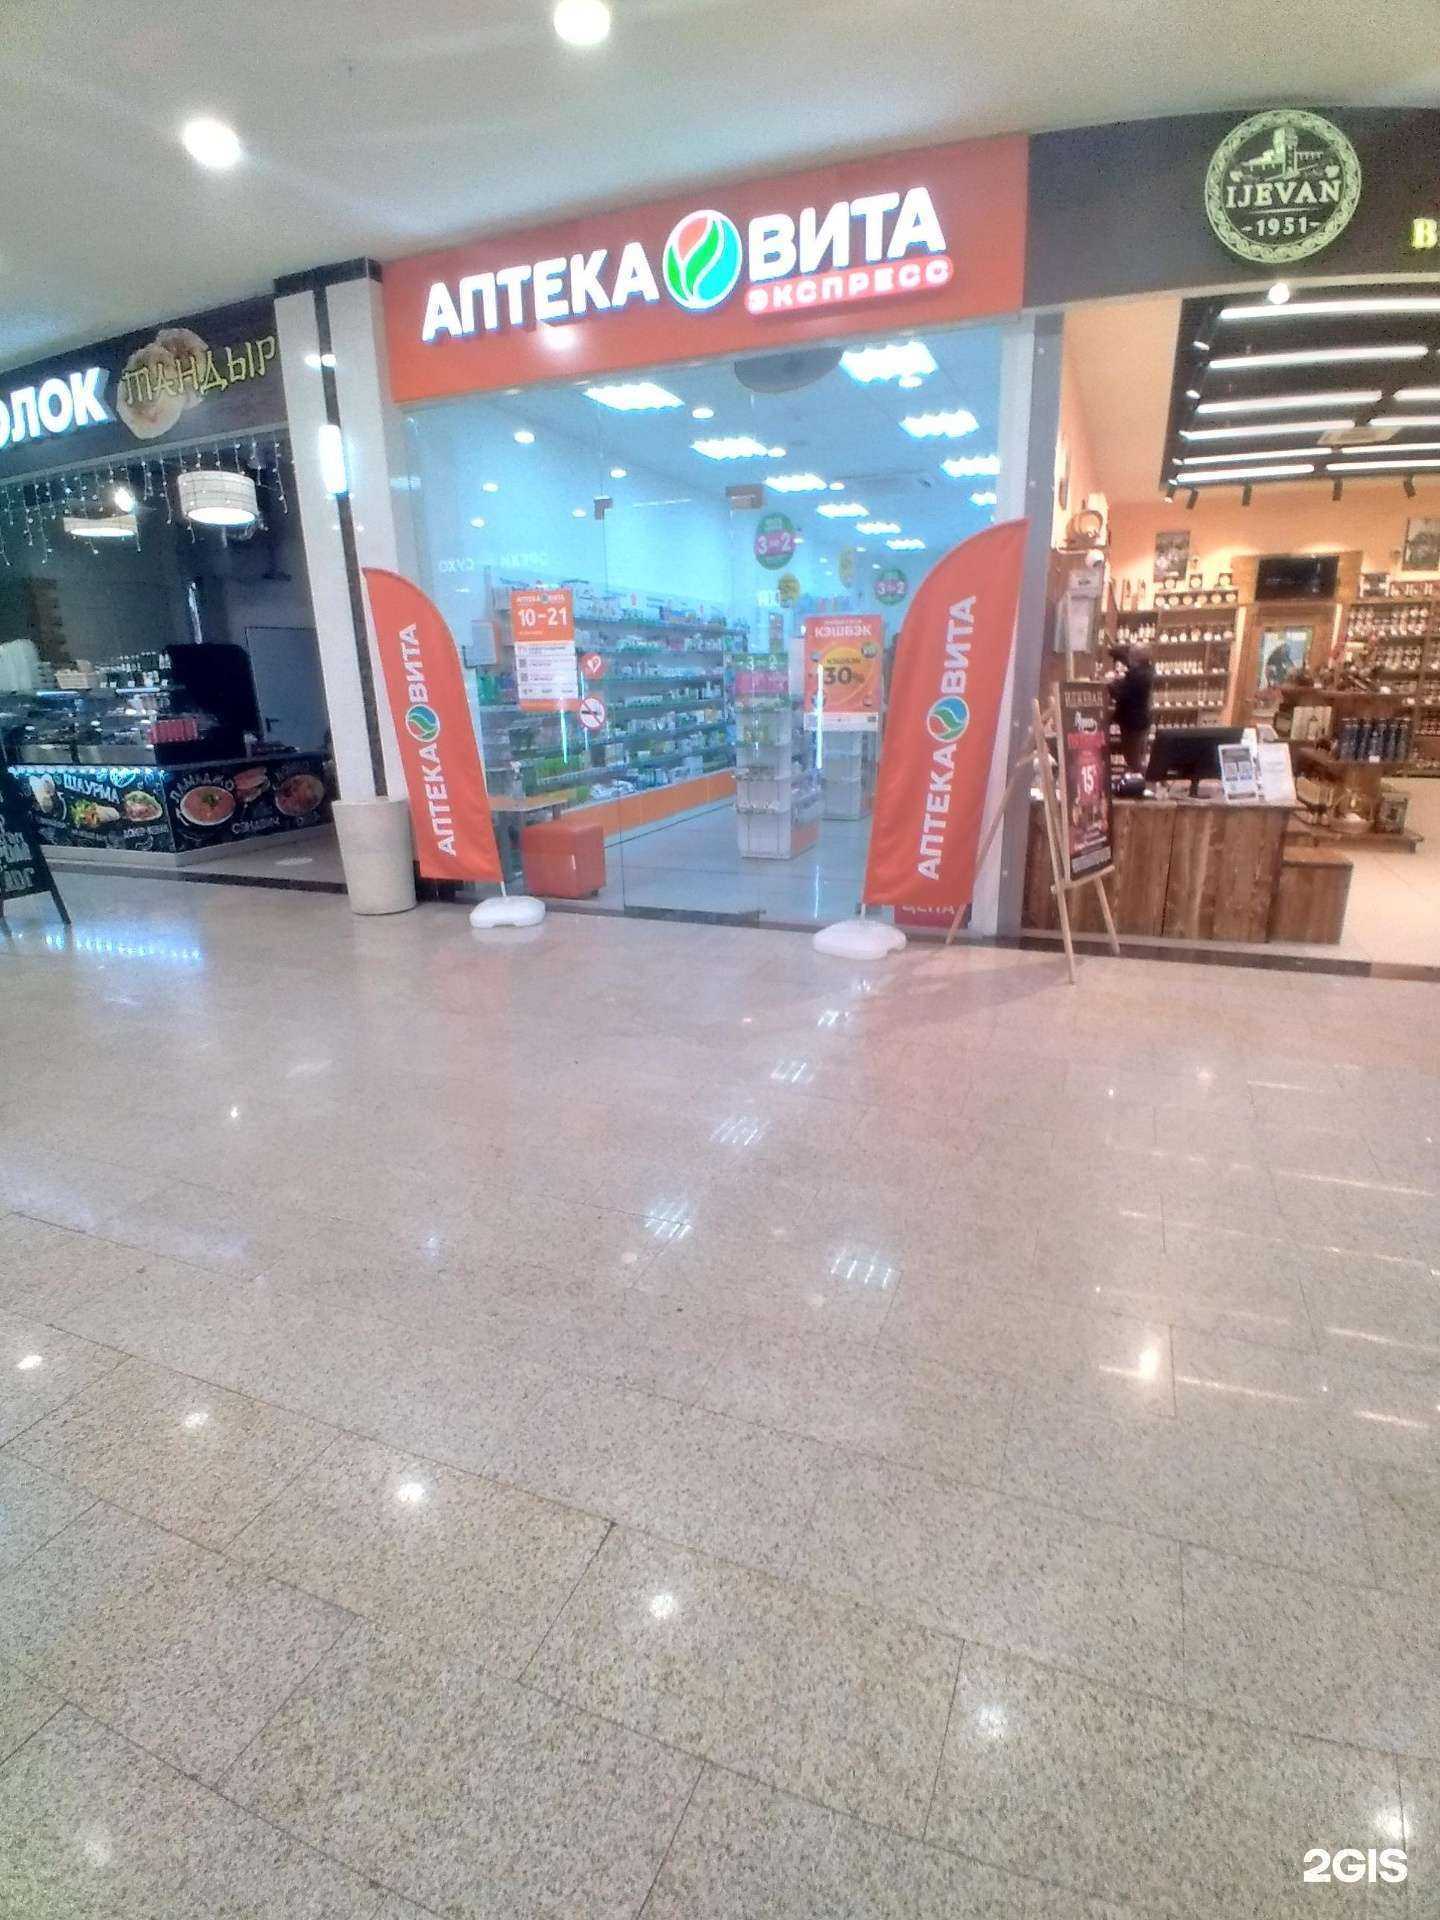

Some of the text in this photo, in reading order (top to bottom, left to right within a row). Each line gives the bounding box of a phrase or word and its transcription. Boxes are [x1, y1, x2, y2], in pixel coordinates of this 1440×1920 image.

[1226, 180, 1342, 208] IJEVAN
[422, 187, 948, 343] АПТЕКА ВИТА
[748, 259, 950, 314] ЭКСПРЕСС
[122, 336, 277, 405] ТАНДЫР
[815, 625, 872, 637] КЭШБЭК
[400, 623, 457, 857] АПТЕКА ВИТА
[918, 743, 958, 881] АПТЕКА
[940, 596, 977, 695] ВИТА
[63, 773, 121, 805] ШАУРМА
